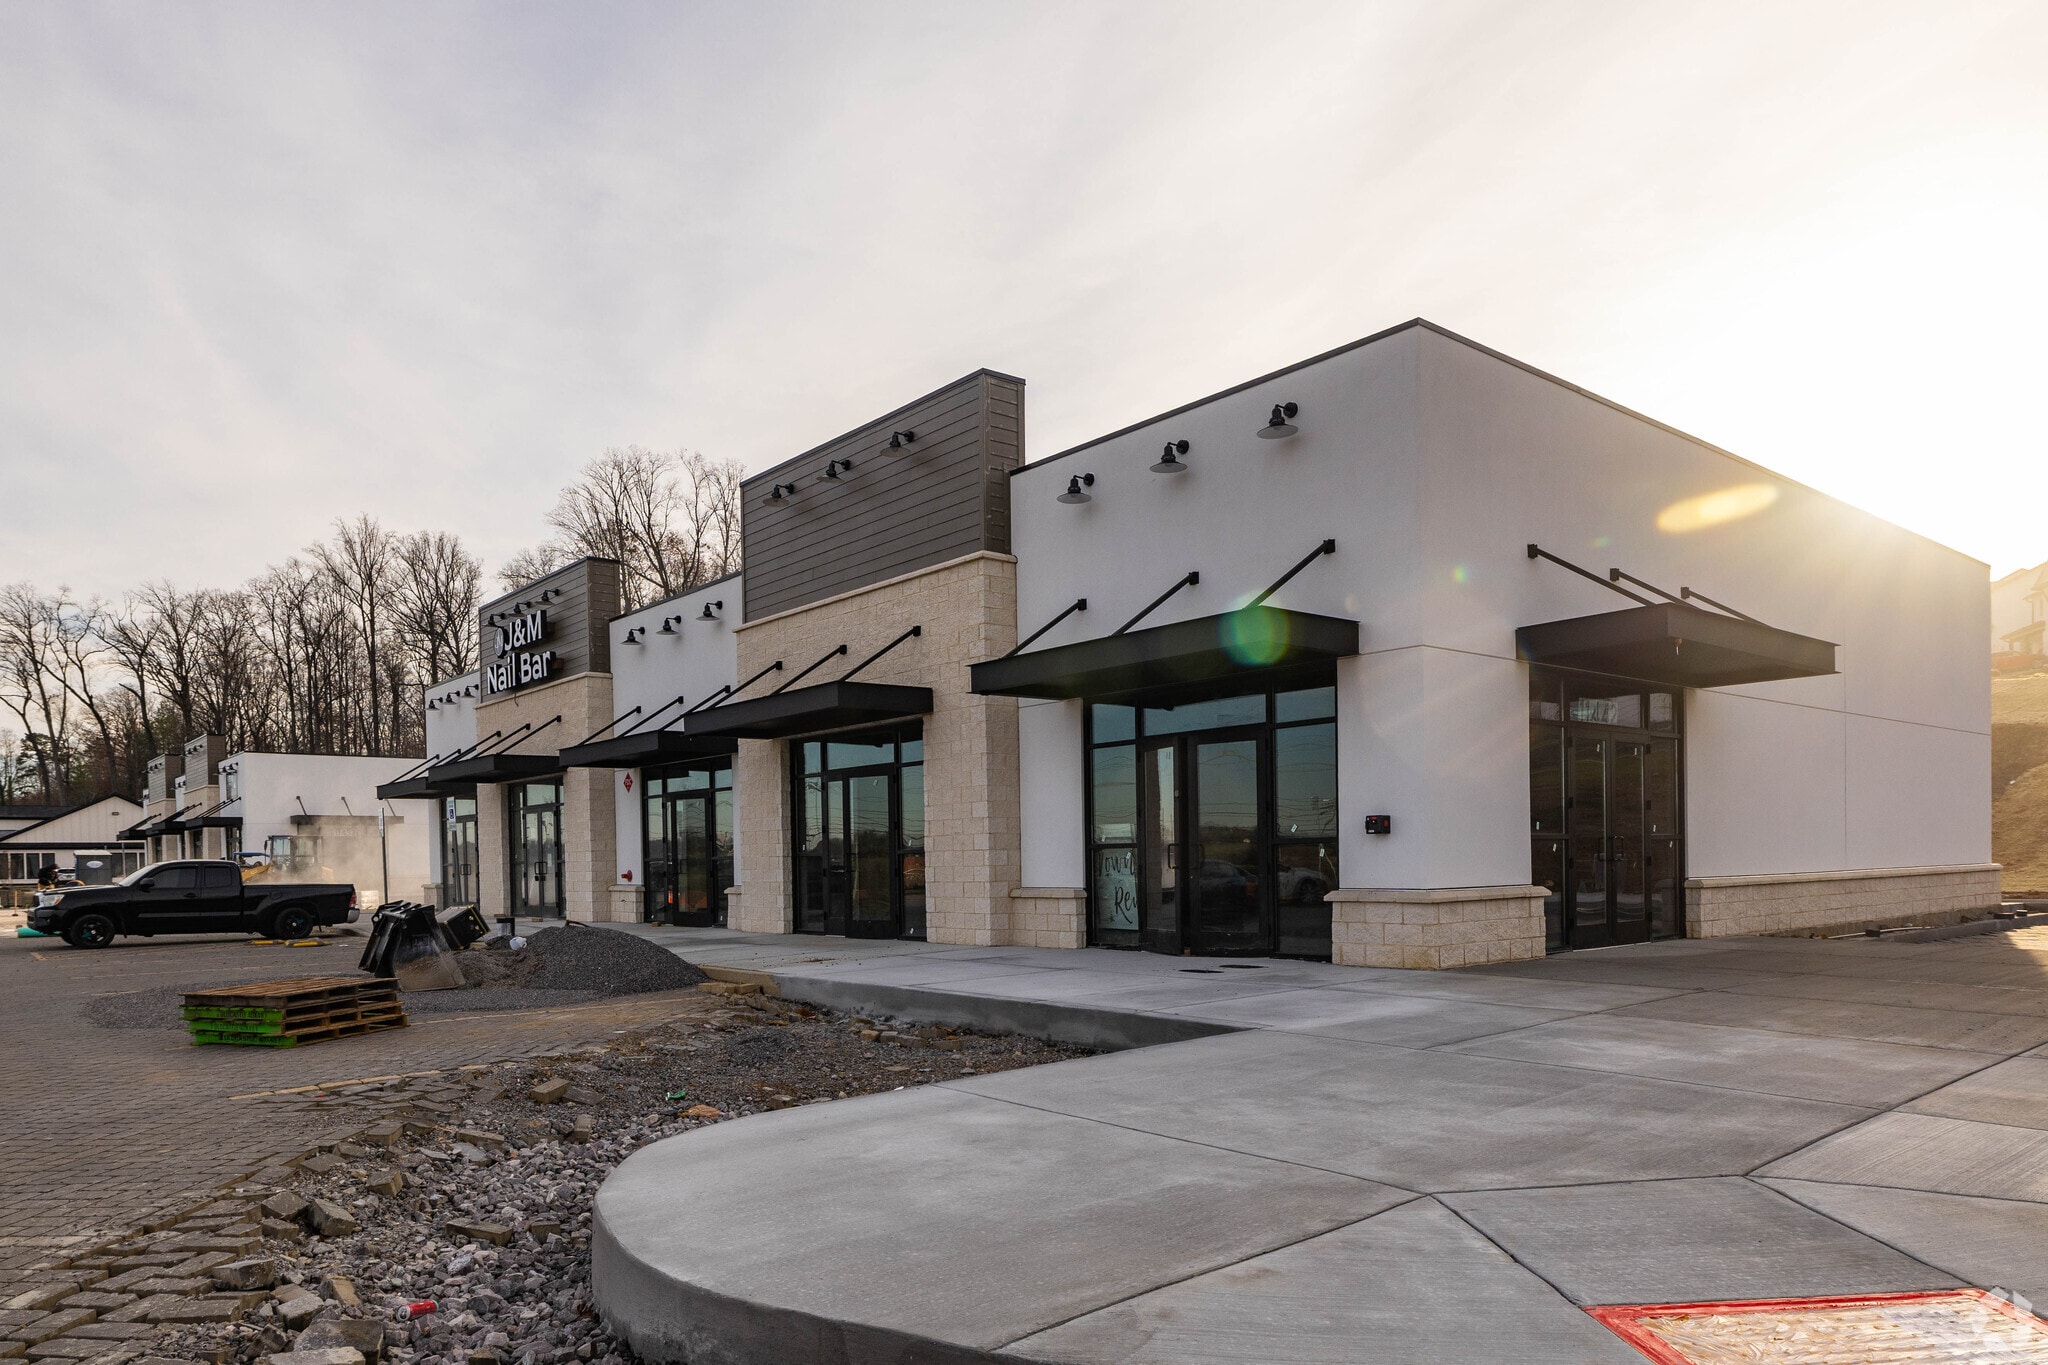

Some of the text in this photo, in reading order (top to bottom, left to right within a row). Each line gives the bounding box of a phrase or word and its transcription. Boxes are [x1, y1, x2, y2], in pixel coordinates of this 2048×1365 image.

[504, 610, 542, 651] J&M
[487, 650, 551, 694] Nail Bar
